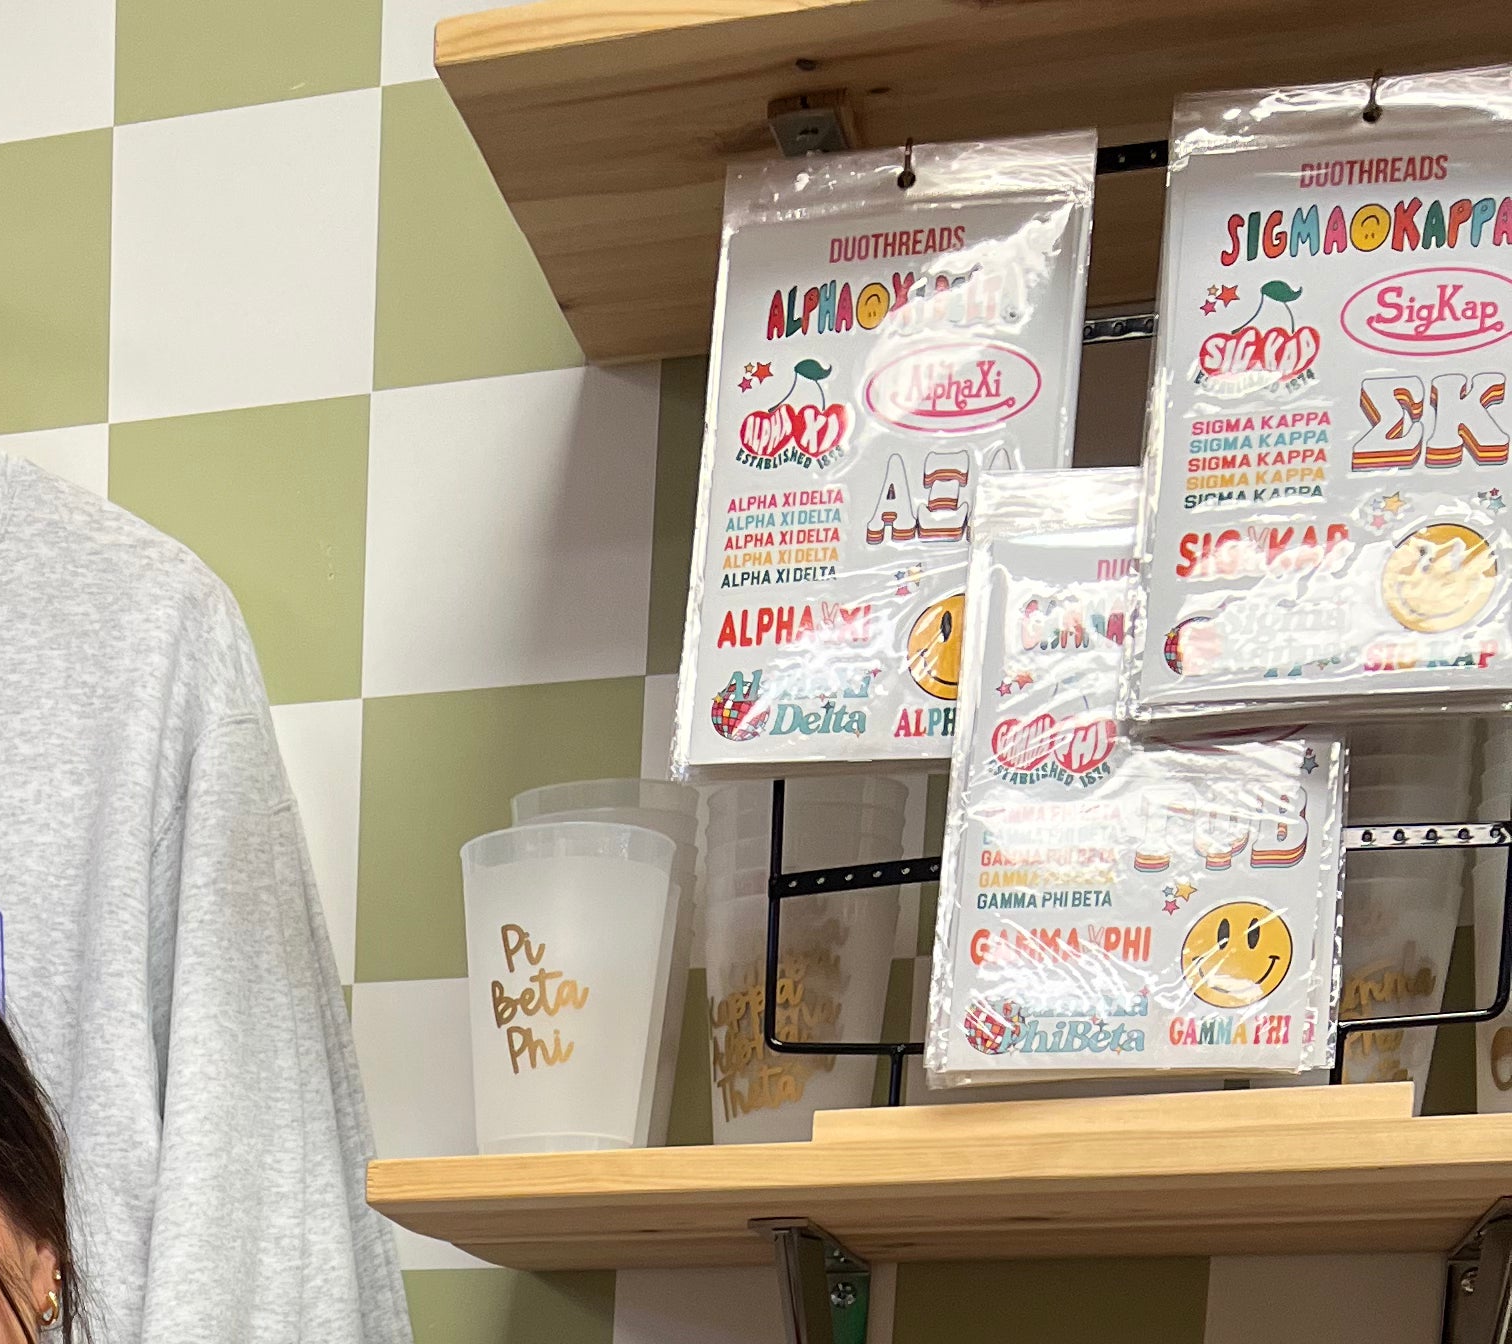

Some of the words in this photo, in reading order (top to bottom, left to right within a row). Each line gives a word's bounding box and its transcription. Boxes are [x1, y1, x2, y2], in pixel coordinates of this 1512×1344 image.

[1299, 154, 1449, 189] DUOTHREADS
[828, 225, 966, 264] DUOTHREADS
[1220, 203, 1348, 267] SIGMA
[766, 279, 855, 341] ALPHA
[1191, 416, 1256, 437] SIGMA
[1260, 411, 1332, 432] KAPPA
[1189, 434, 1254, 454] SIGMA
[1257, 430, 1330, 450] KAPPA
[735, 446, 812, 470] ESTABLISHED
[1187, 453, 1252, 473] SIGMA
[1256, 448, 1328, 468] KAPPA
[1185, 471, 1250, 491] SIGMA
[1255, 466, 1326, 487] KAPPA
[727, 492, 778, 514] ALPHA
[781, 491, 798, 508] XI
[799, 488, 844, 506] DELTA
[725, 511, 776, 533] ALPHA
[780, 510, 795, 527] XI
[797, 508, 842, 526] DELTA
[723, 530, 775, 552] ALPHA
[778, 530, 794, 546] XI
[796, 527, 841, 544] DELTA
[722, 550, 773, 571] ALPHA
[777, 549, 792, 565] XI
[794, 546, 839, 563] DELTA
[720, 568, 771, 589] ALPHA
[775, 567, 791, 583] XI
[792, 565, 838, 583] DELTA
[716, 604, 815, 649] ALPHA
[769, 701, 868, 737] Delta
[892, 706, 958, 738] ALPH
[976, 892, 1038, 910] GAMMA
[1041, 891, 1069, 908] PHI
[1071, 890, 1113, 908] BETA
[500, 922, 546, 974] Pi
[969, 926, 1083, 967] GAMMA
[1103, 926, 1153, 963] PHI
[1168, 1015, 1249, 1047] GAMMA
[1253, 1014, 1292, 1047] PHI
[506, 1025, 575, 1075] Phi
